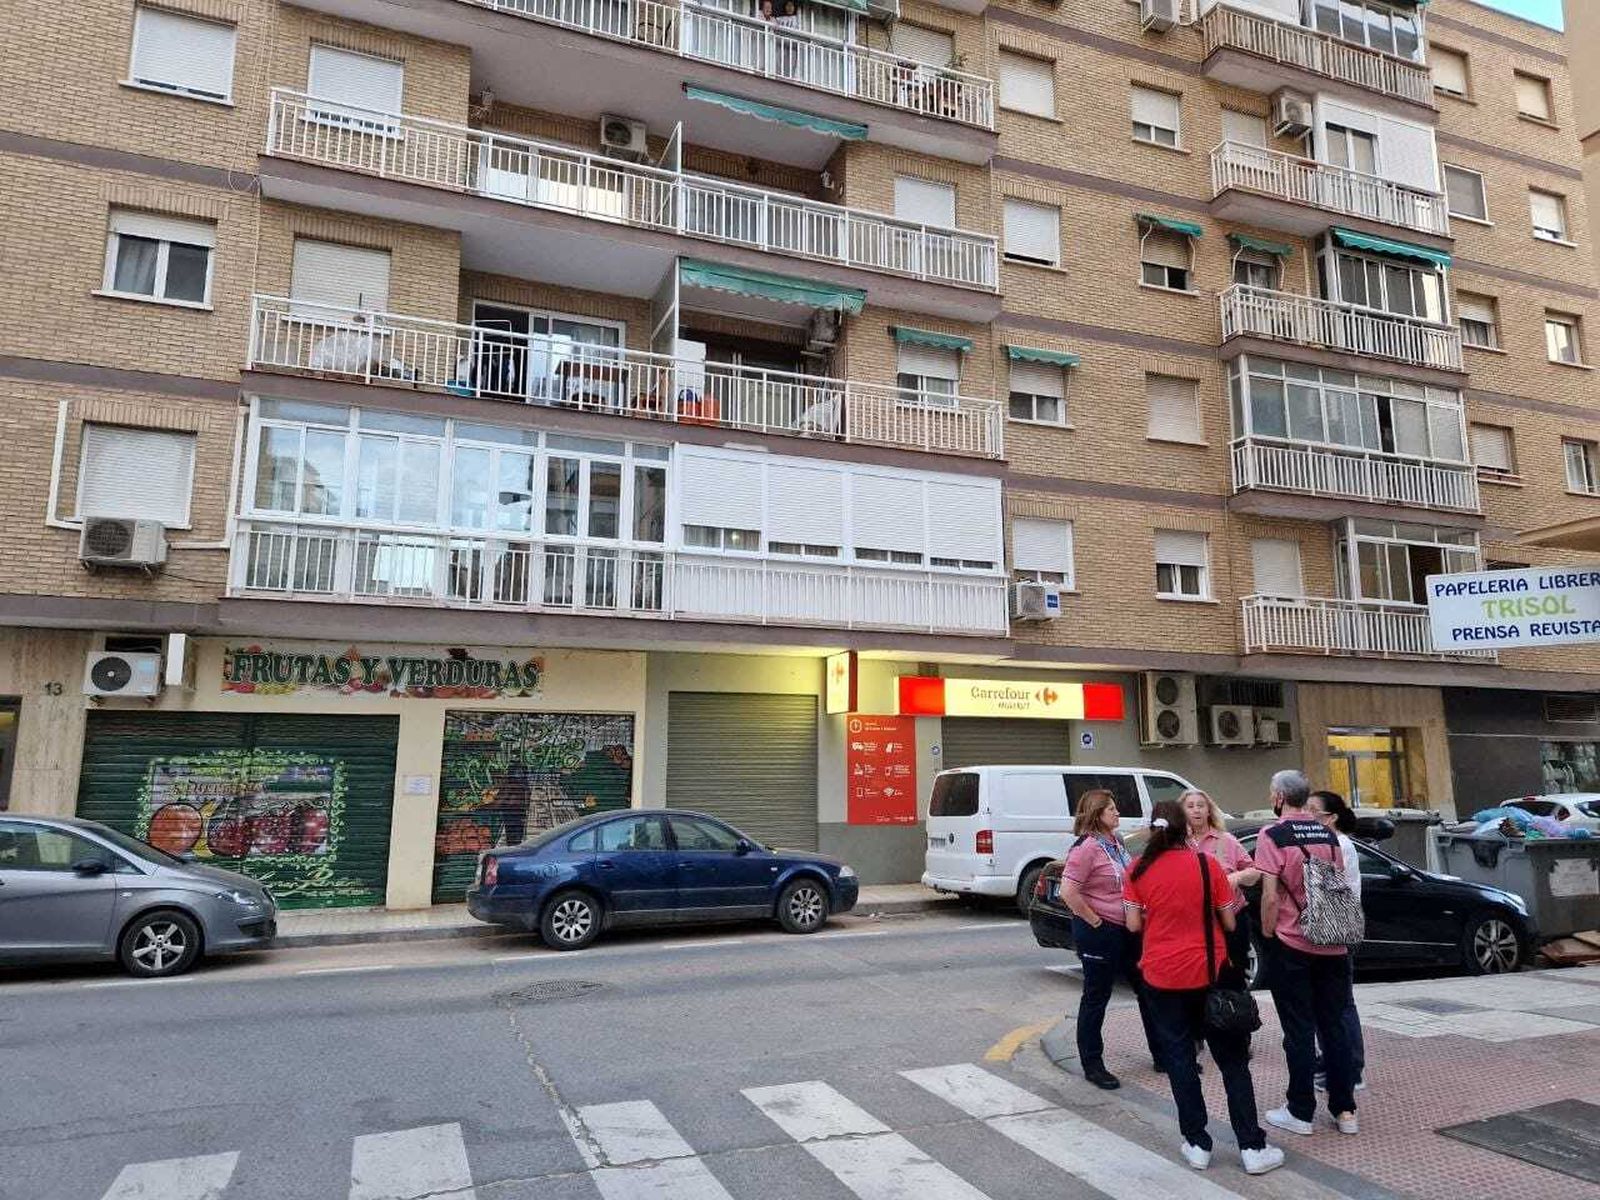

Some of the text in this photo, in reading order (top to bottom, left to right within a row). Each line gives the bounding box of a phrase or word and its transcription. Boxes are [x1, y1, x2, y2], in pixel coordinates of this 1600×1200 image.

[1434, 578, 1529, 597] PAPELERIA
[1481, 595, 1576, 619] TRISOL
[1452, 624, 1520, 641] PRENSA
[231, 653, 539, 689] FRUTAS Y VERDURAS
[44, 682, 63, 697] 13
[970, 685, 1031, 701] Carrefour
